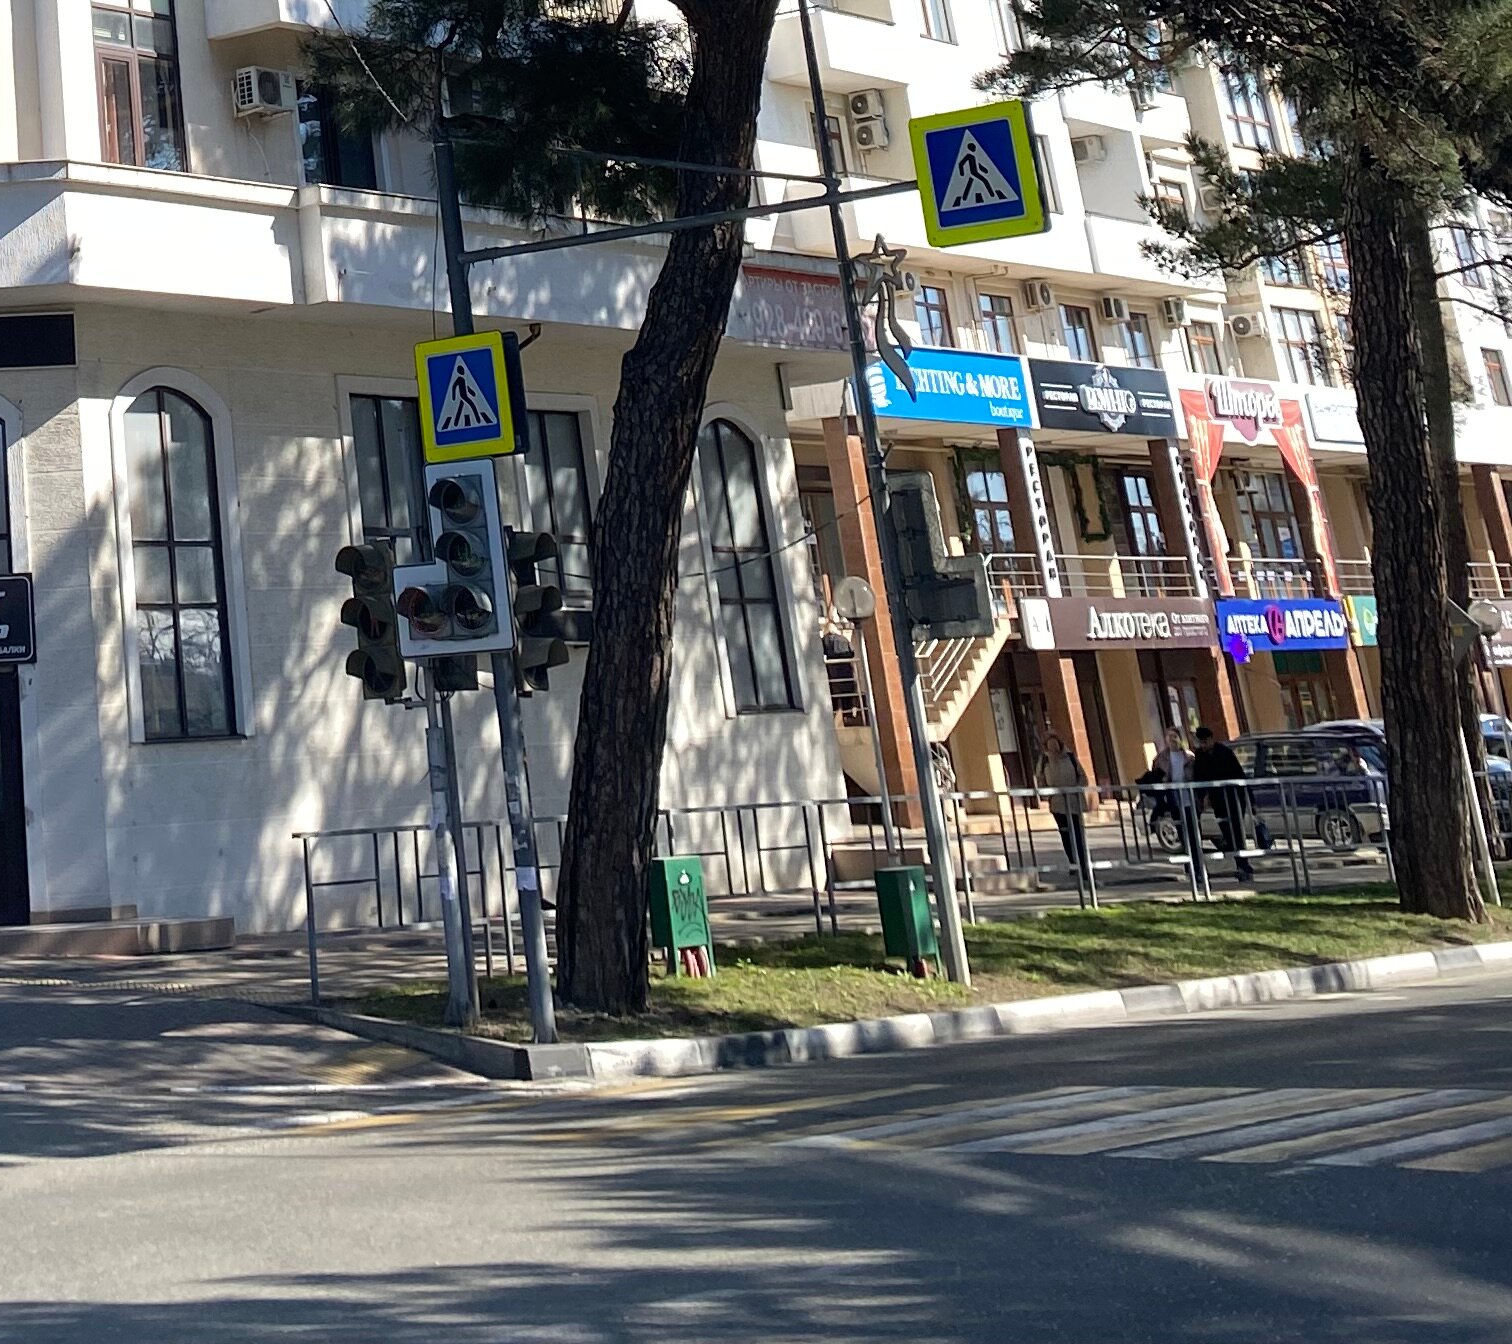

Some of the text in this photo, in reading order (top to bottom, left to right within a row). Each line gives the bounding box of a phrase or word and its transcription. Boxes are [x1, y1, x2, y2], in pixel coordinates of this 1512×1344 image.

[966, 373, 979, 397] &
[980, 373, 1022, 401] MORE
[989, 401, 1024, 422] boutique
[1226, 614, 1269, 634] АПТЕКА
[1285, 609, 1345, 638] АПРЕЛЬ
